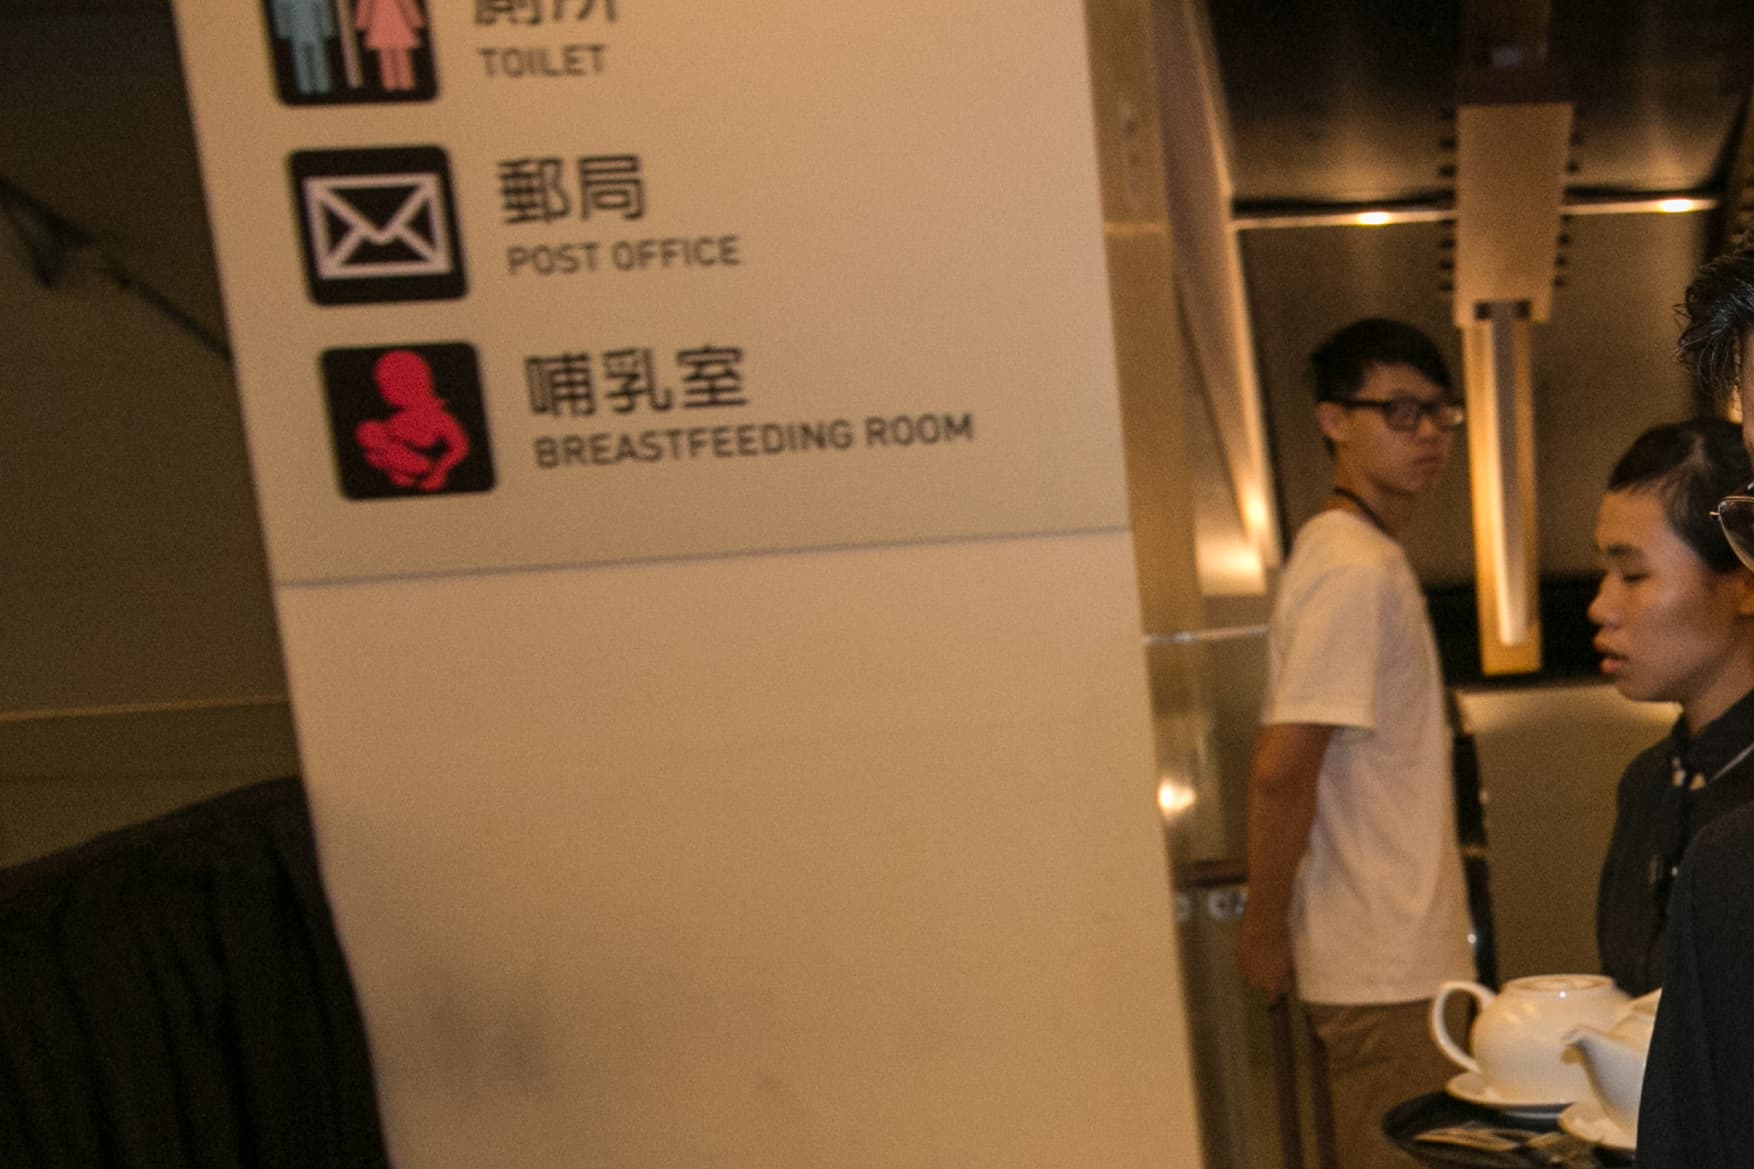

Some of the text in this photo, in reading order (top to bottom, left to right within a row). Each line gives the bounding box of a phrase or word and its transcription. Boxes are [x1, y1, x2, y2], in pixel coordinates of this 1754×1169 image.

[476, 44, 606, 78] TOILET
[498, 154, 645, 224] 郵局
[506, 235, 741, 275] POST OFFICE
[525, 345, 747, 417] 哺乳室
[534, 413, 975, 468] BREASTFEEDING ROOM
